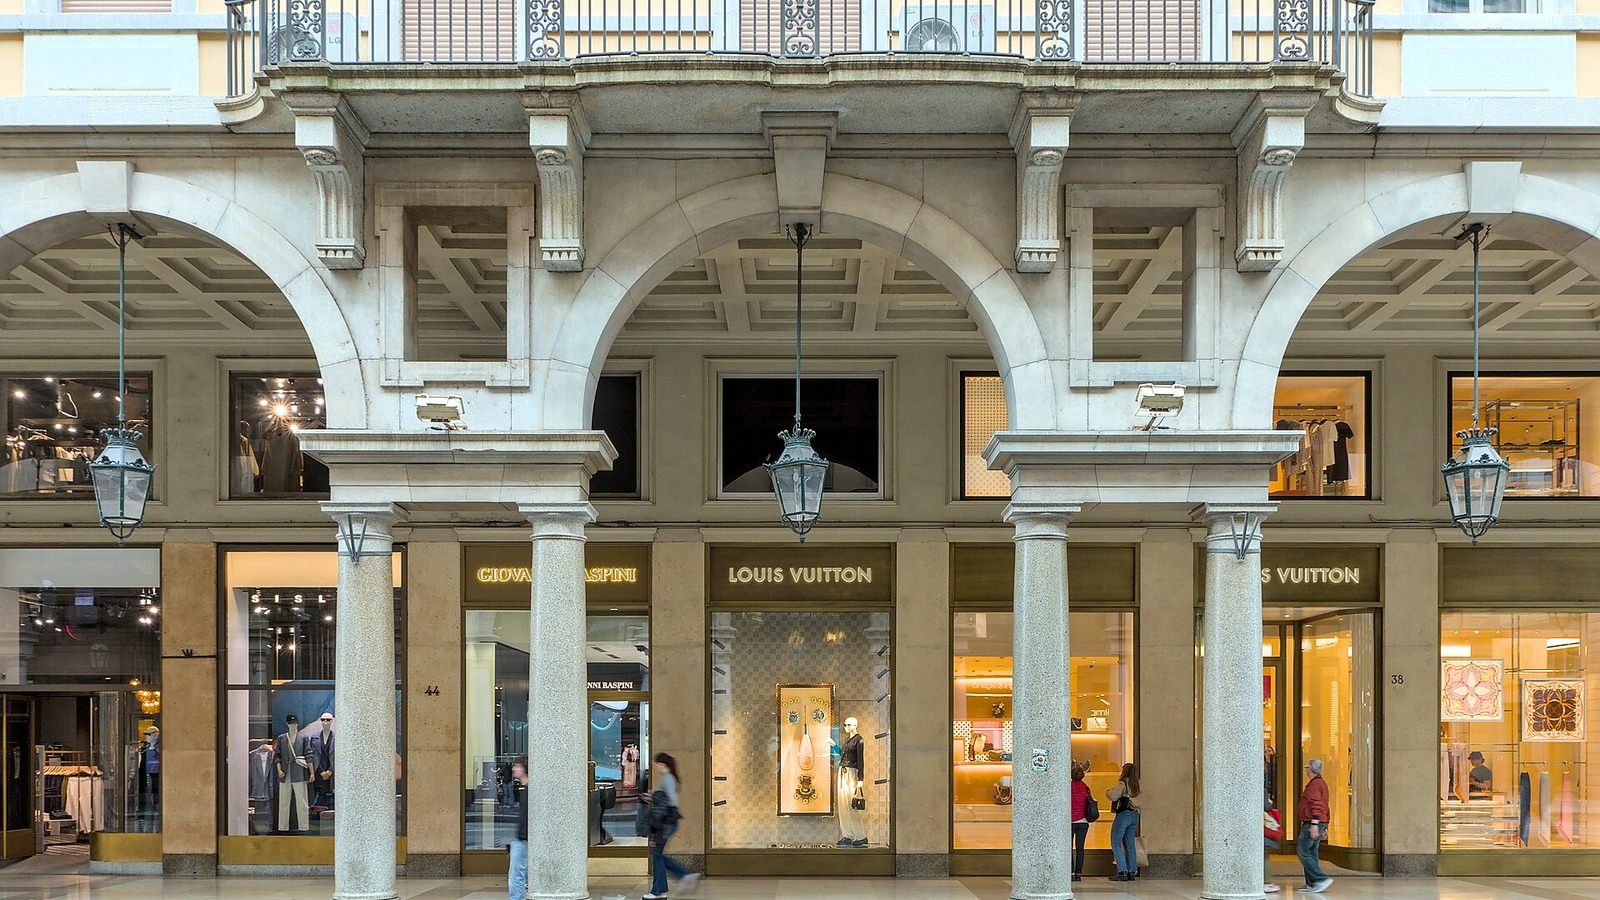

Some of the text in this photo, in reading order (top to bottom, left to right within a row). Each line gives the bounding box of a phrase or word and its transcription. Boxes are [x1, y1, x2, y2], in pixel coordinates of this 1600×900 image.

[328, 36, 341, 44] LG
[477, 567, 637, 582] GIOVA ASPINI
[728, 566, 872, 583] LOUIS VUITTON
[1276, 566, 1360, 584] VUITTON
[251, 594, 327, 604] SISL
[602, 681, 633, 689] RASPINI
[1391, 674, 1404, 685] 38
[424, 685, 440, 696] 44
